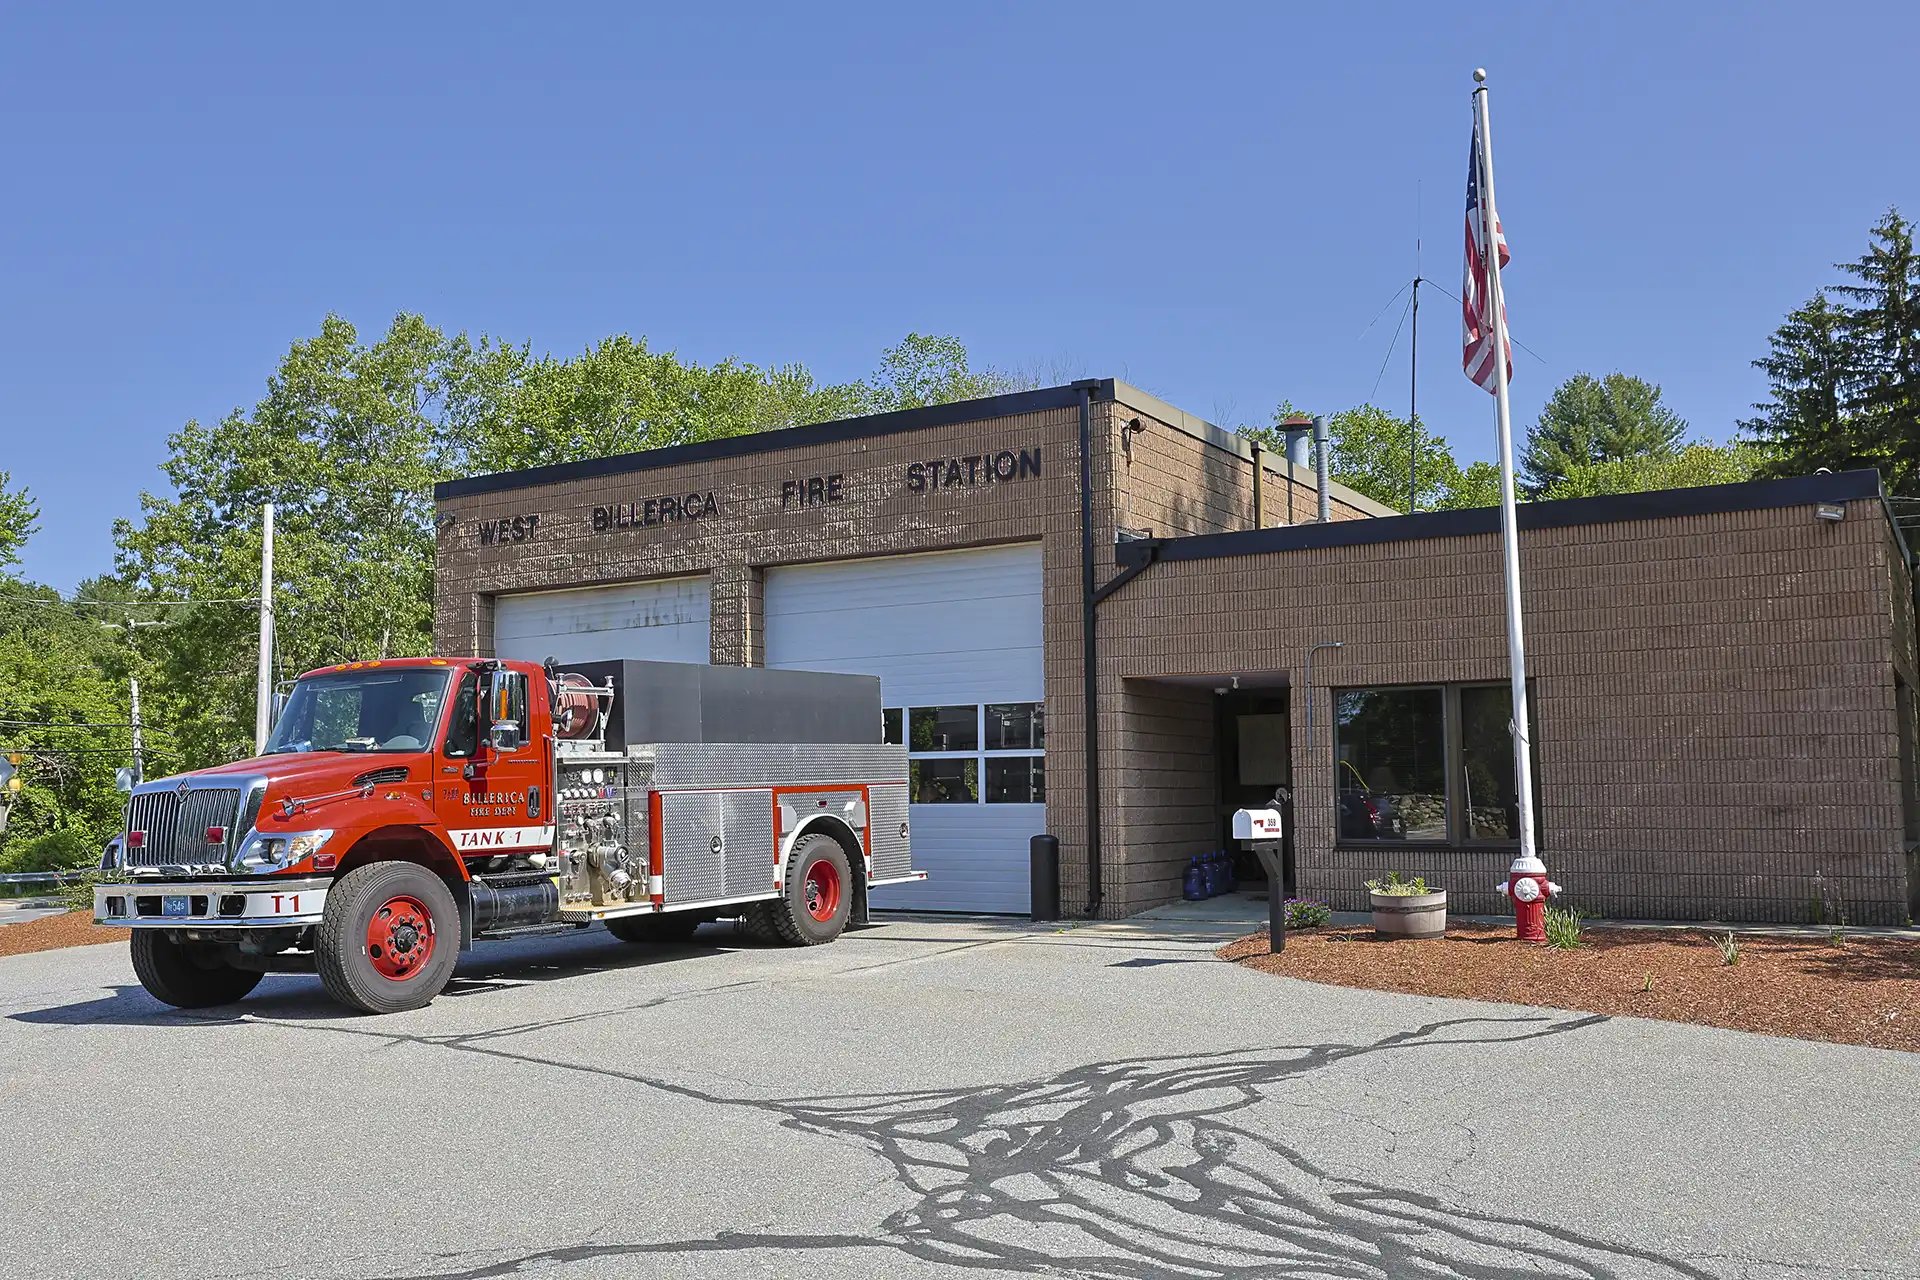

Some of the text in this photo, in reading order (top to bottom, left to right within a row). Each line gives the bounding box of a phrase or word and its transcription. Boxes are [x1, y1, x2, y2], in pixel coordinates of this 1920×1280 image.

[479, 448, 1041, 546] WEST BILLERICA FIRE STATION
[463, 791, 525, 806] BILLERICA
[469, 806, 518, 818] FIRE DEPT
[461, 830, 522, 847] TANK 1
